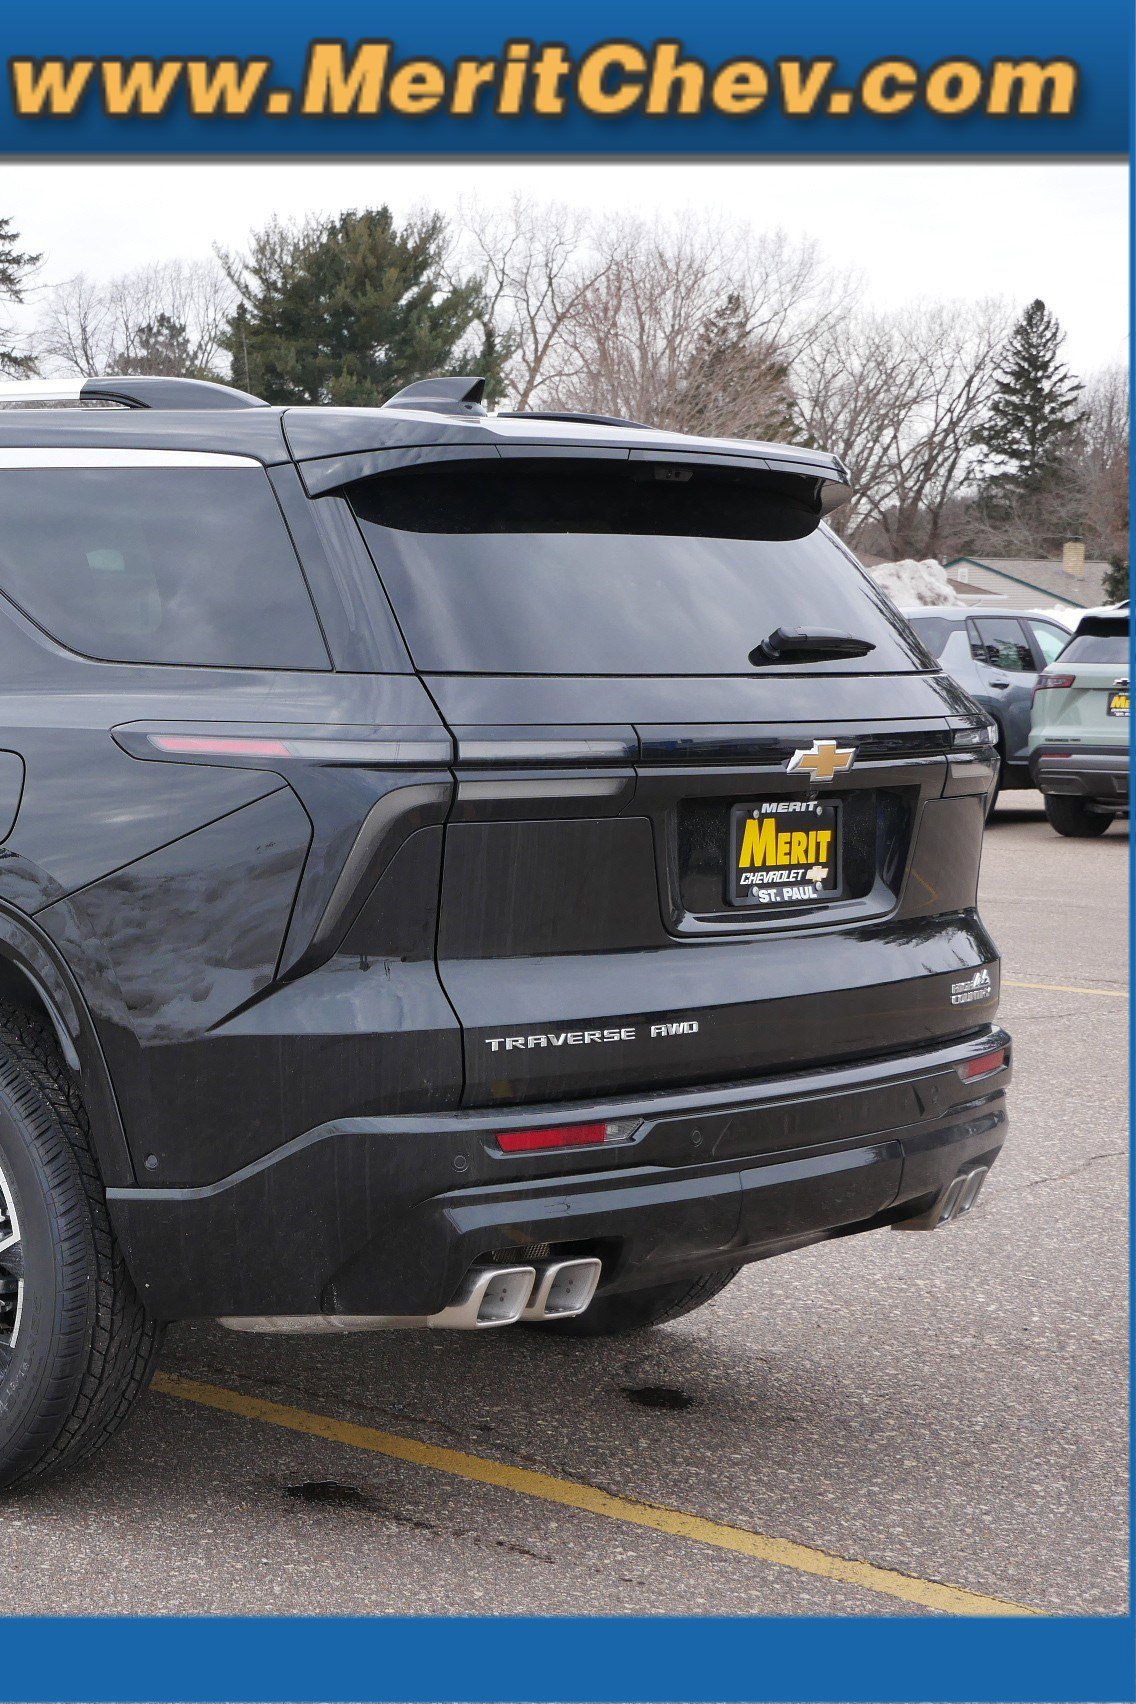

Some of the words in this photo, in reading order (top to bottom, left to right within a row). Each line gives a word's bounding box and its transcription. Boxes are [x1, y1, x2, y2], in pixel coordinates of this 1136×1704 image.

[761, 801, 818, 813] MERIT
[739, 818, 831, 867] MERIT
[740, 869, 805, 885] CHEVROLET
[758, 889, 781, 903] ST.
[783, 886, 818, 901] PAUL
[485, 1027, 636, 1052] TRAVERSE
[650, 1021, 699, 1038] AWD
